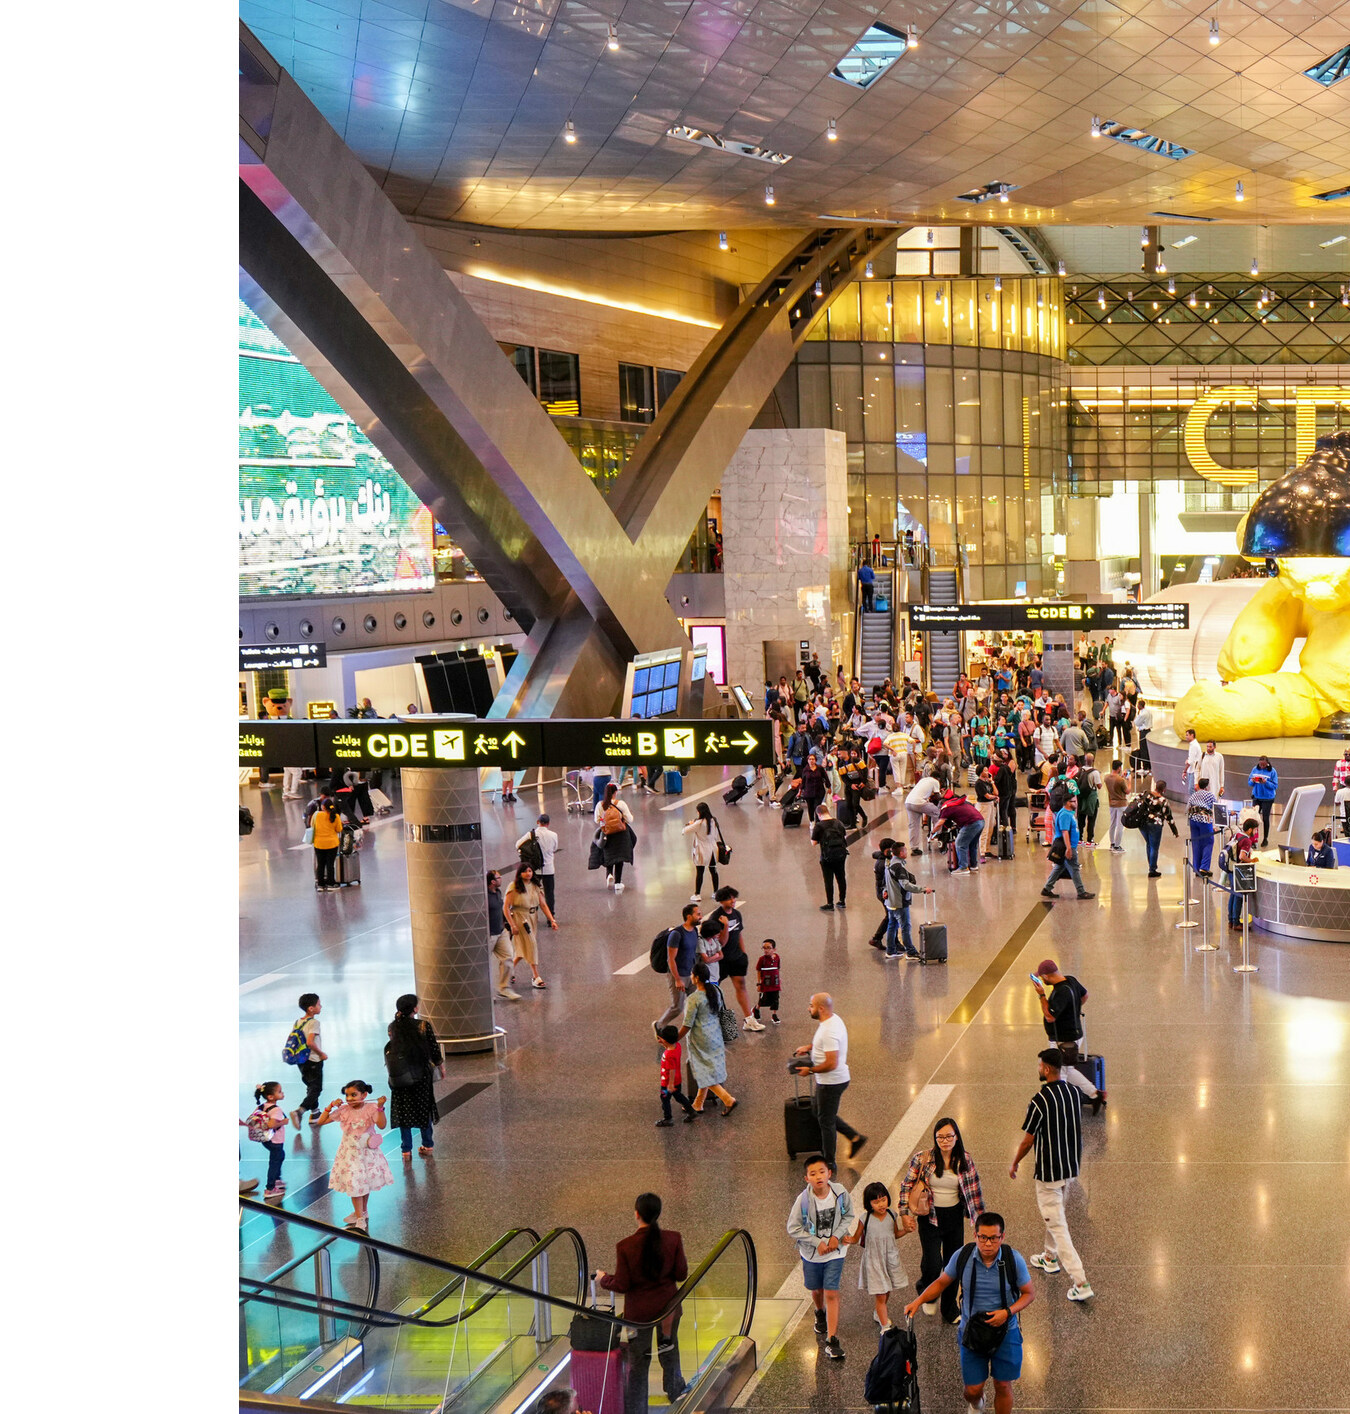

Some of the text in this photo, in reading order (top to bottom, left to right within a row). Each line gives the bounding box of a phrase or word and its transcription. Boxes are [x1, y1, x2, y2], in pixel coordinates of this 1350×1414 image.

[1039, 607, 1068, 619] CDE
[332, 734, 361, 747] بوابات
[487, 737, 498, 746] 10
[602, 732, 632, 745] بوابات
[637, 732, 658, 756] B
[366, 733, 429, 758] CDE
[605, 747, 632, 756] Gates
[335, 749, 361, 758] Gates
